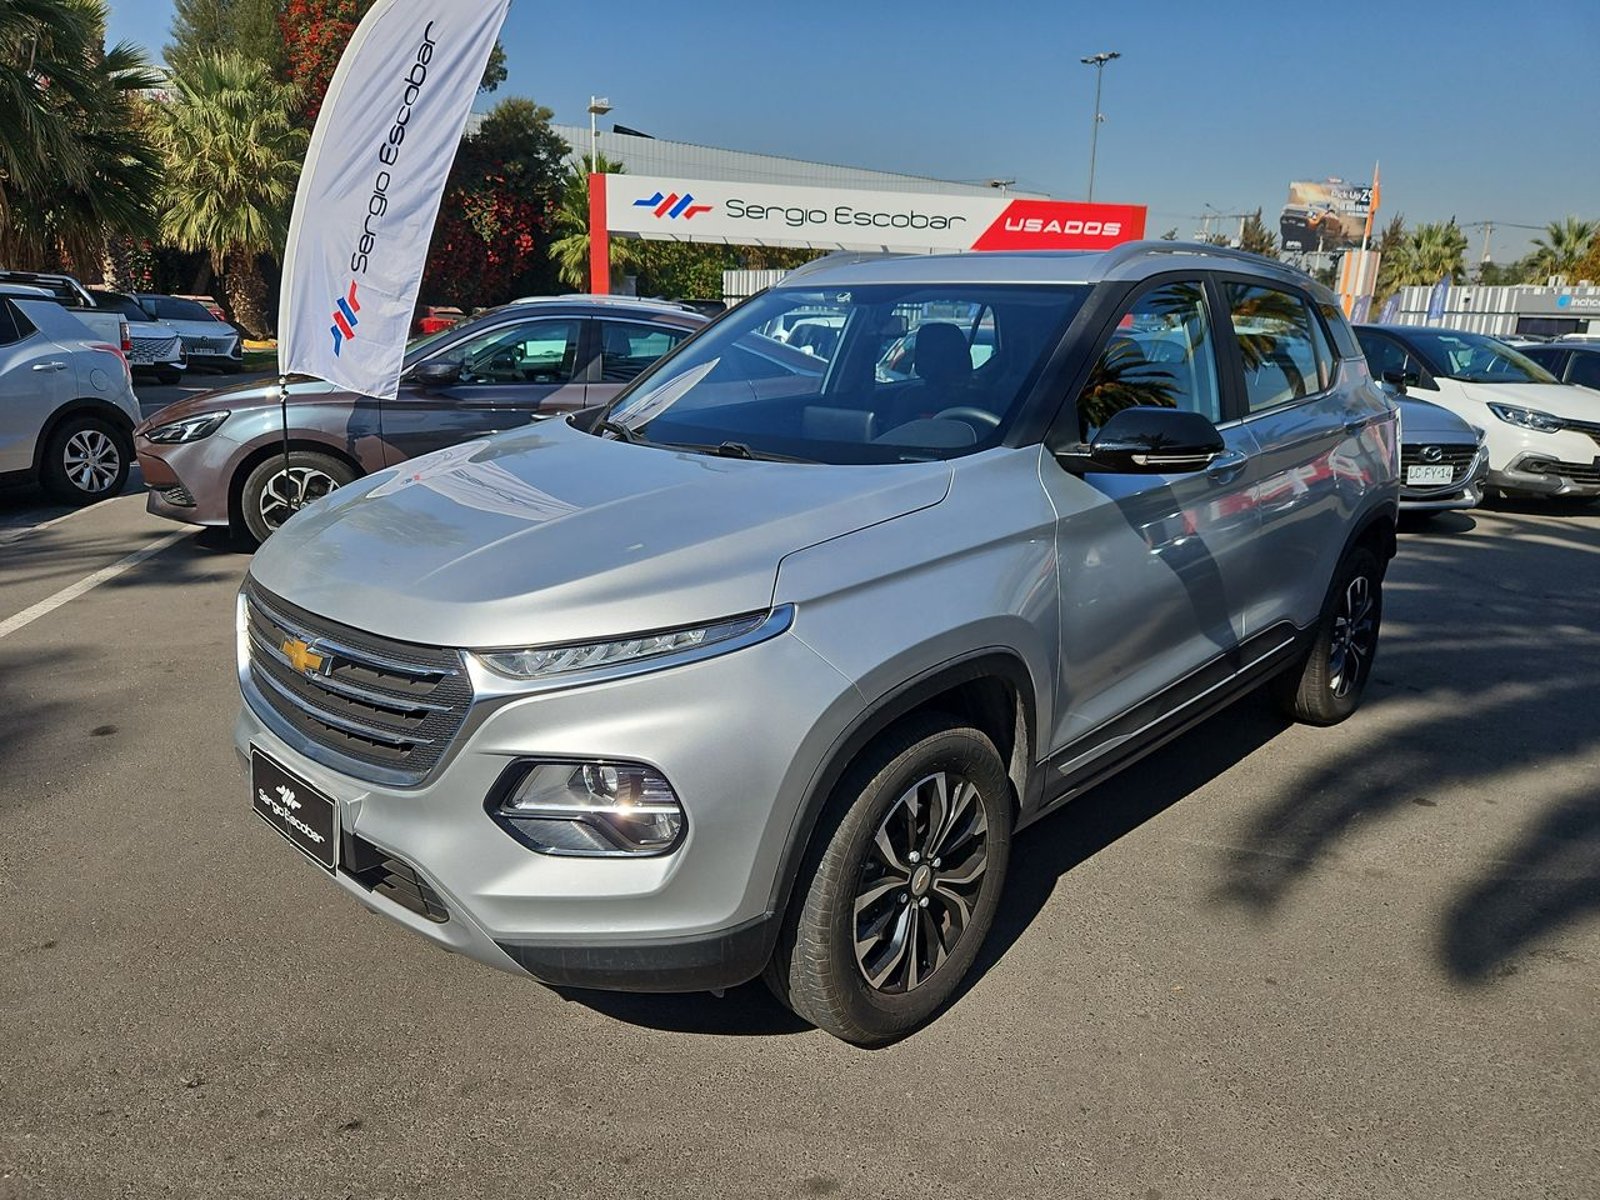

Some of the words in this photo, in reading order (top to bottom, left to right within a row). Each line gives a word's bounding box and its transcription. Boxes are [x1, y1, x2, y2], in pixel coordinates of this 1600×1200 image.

[351, 171, 391, 274] Sergio
[379, 20, 436, 166] Escobar
[726, 199, 828, 227] Sergio
[834, 206, 967, 230] Escobar
[1004, 217, 1122, 237] USADOS
[1571, 296, 1600, 307] inchc
[258, 788, 285, 816] Sergio
[284, 807, 326, 843] Escobar
